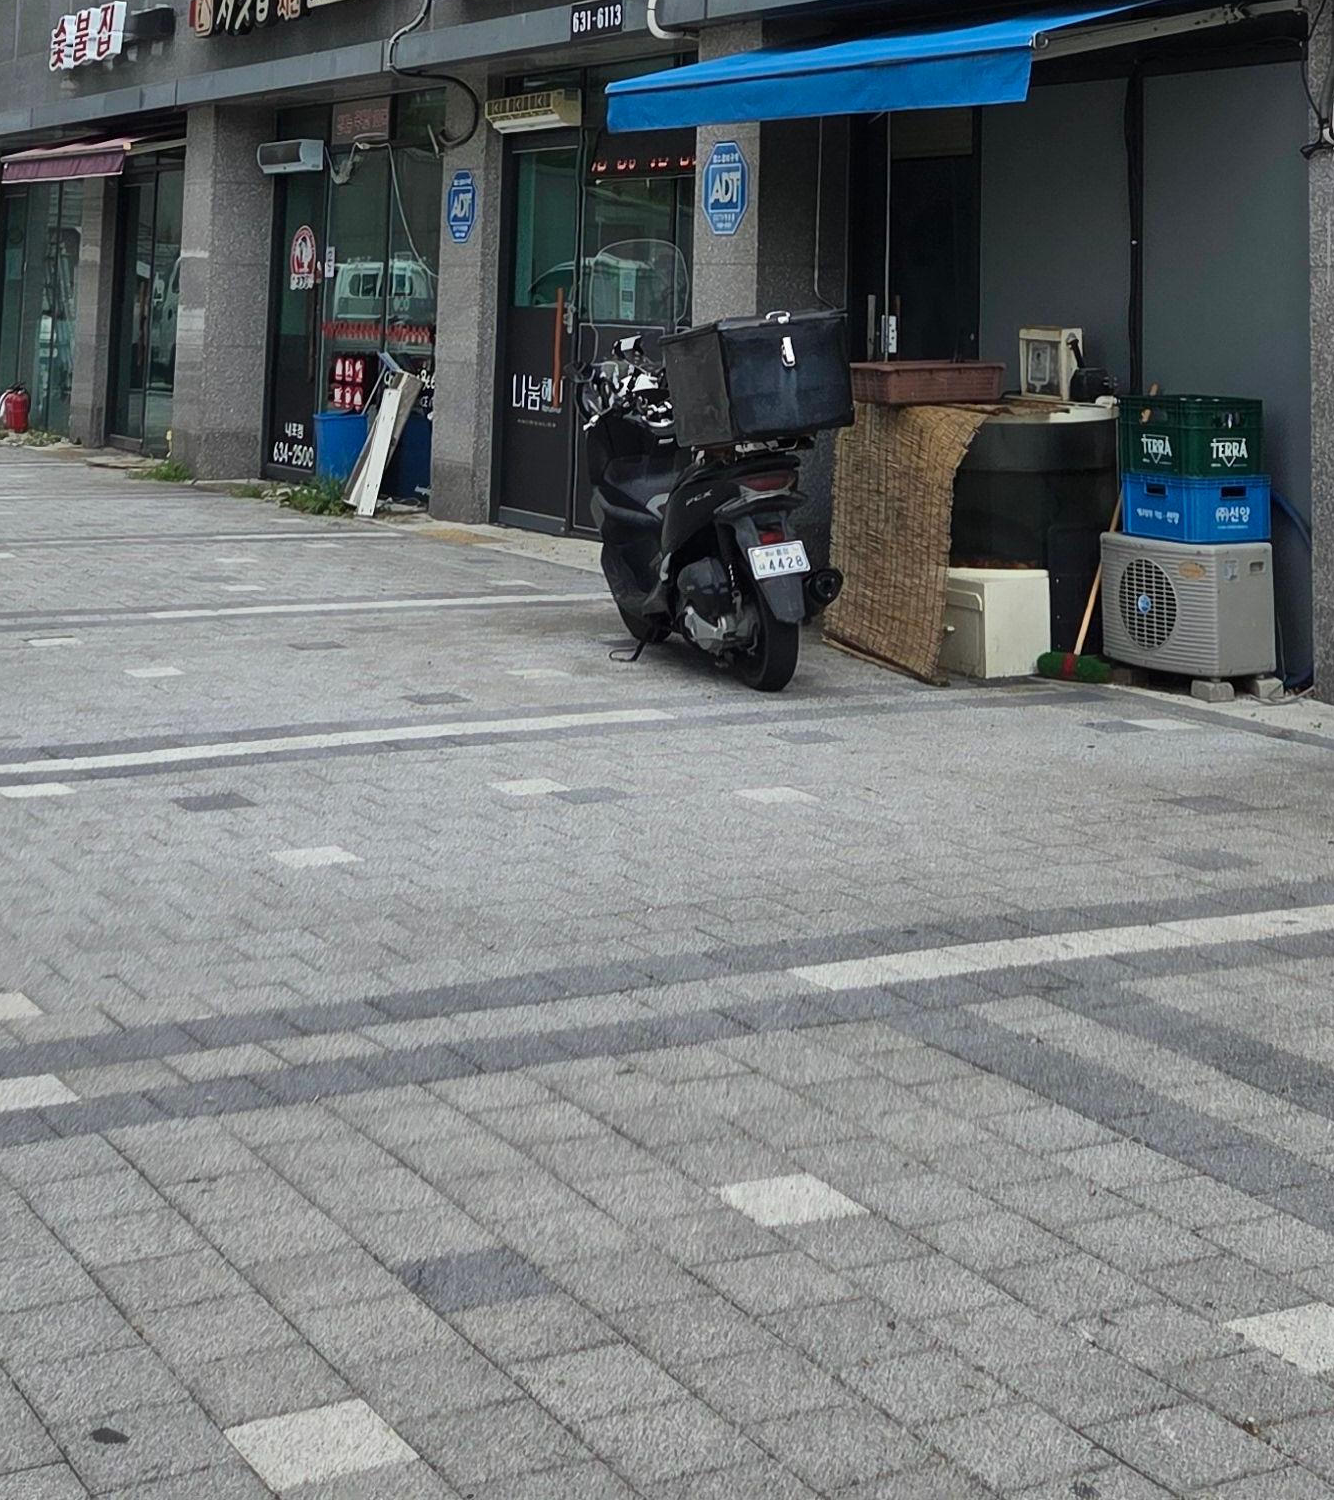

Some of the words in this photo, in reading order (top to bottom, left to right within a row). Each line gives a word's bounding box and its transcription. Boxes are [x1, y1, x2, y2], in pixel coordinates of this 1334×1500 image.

[572, 3, 622, 33] 631-6113
[710, 171, 741, 204] ADT
[450, 192, 473, 219] ADT
[1141, 437, 1173, 457] TERRA
[1210, 439, 1248, 460] TERRA
[769, 555, 804, 571] 4428
